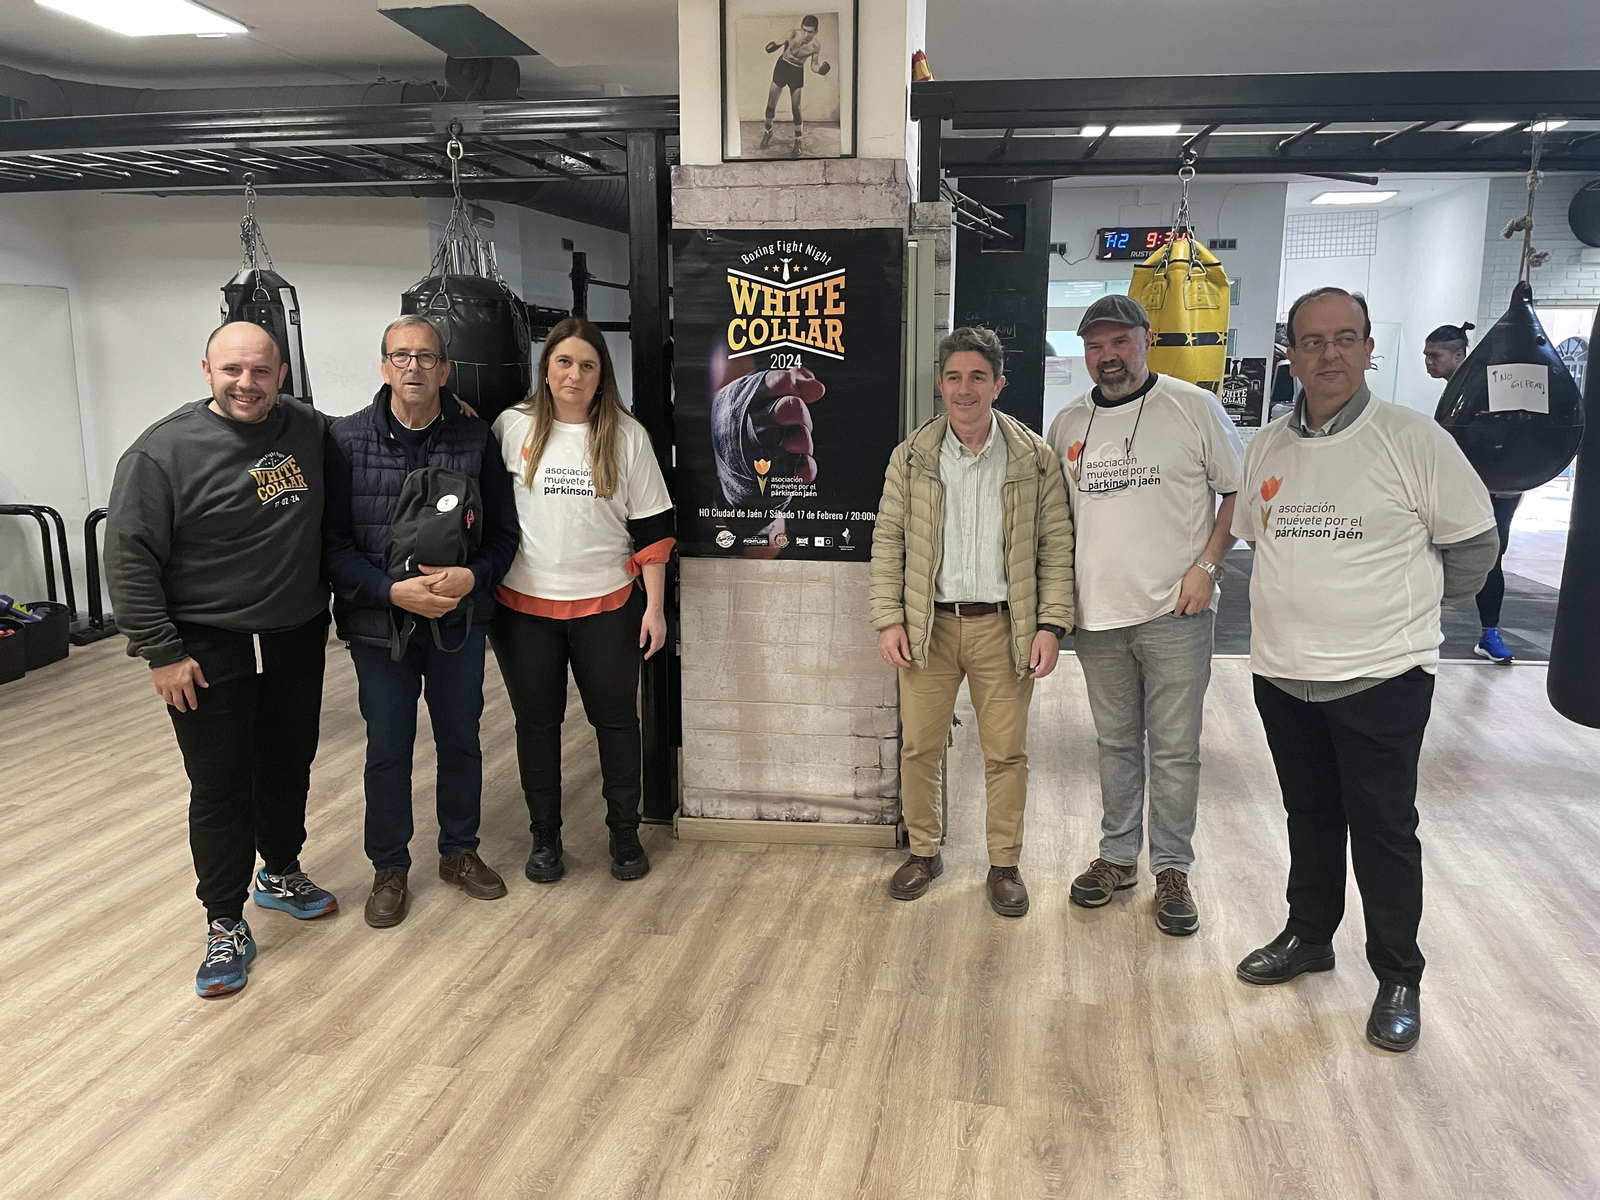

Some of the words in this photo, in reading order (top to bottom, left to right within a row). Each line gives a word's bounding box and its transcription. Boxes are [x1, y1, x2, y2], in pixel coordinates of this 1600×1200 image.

[740, 244, 774, 265] Boxing
[777, 240, 803, 254] Fight
[805, 244, 832, 266] Night
[727, 275, 846, 316] WHITE
[727, 318, 845, 354] COLLAR
[770, 354, 802, 369] 2024
[1086, 457, 1137, 469] asociación
[250, 458, 301, 486] WHITE
[1086, 467, 1128, 480] muévete
[1130, 466, 1148, 478] por
[1150, 465, 1160, 474] el
[256, 474, 308, 501] COLLAR
[544, 476, 585, 486] muévete
[1138, 476, 1160, 488] jaén
[544, 485, 593, 496] párkinson
[699, 508, 710, 518] HO
[712, 508, 735, 518] Ciudad
[736, 509, 746, 518] de
[746, 509, 762, 518] Jaén
[764, 510, 768, 518] /
[770, 510, 794, 519] Sábado
[796, 510, 805, 519] 17
[806, 510, 815, 520] de
[816, 511, 843, 520] Febrero
[844, 512, 848, 520] /
[850, 512, 876, 520] 20:00h
[1278, 502, 1336, 513] asociación
[1276, 514, 1322, 526] muévete
[1324, 516, 1348, 528] por
[1350, 516, 1362, 526] el
[1274, 526, 1330, 540] párkinson
[1332, 528, 1363, 540] jaén
